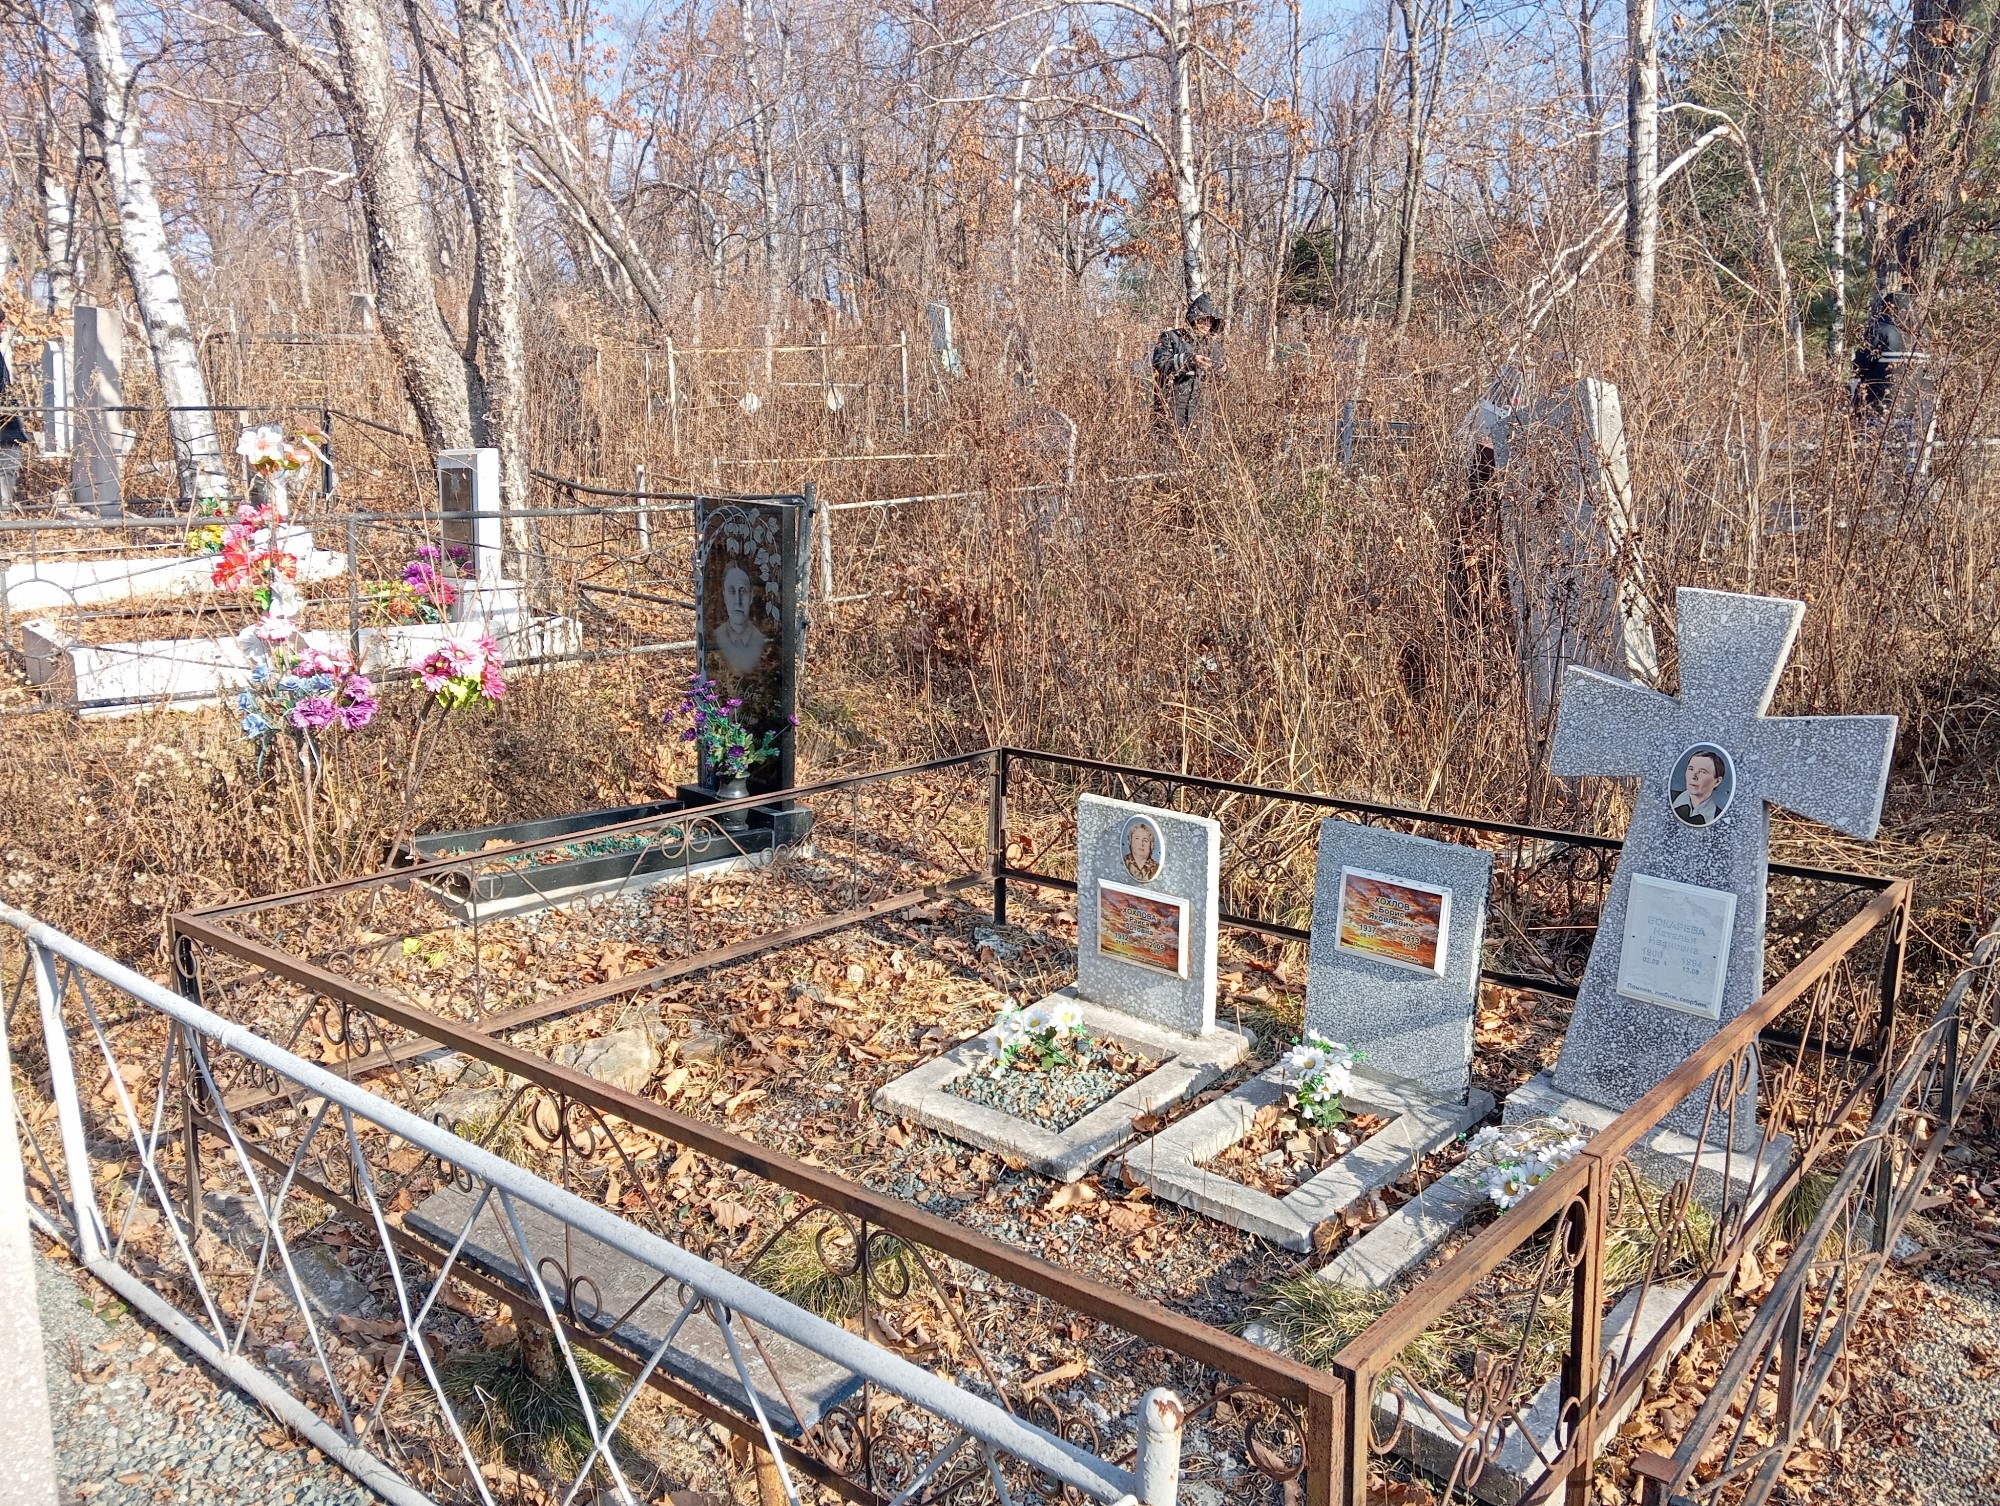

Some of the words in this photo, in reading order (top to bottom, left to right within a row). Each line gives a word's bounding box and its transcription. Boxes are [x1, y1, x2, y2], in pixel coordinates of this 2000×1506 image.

[1375, 897, 1410, 911] ХОХЛОВ
[1122, 907, 1157, 921] ХОХЛОВА
[1378, 907, 1405, 918] Борис
[1129, 917, 1151, 927] Раиса
[1368, 912, 1414, 929] Яковлевич
[1360, 924, 1376, 934] 1937
[1402, 935, 1420, 945] 2013
[1653, 926, 1697, 944] Наталья
[1648, 936, 1699, 955] Ивановна
